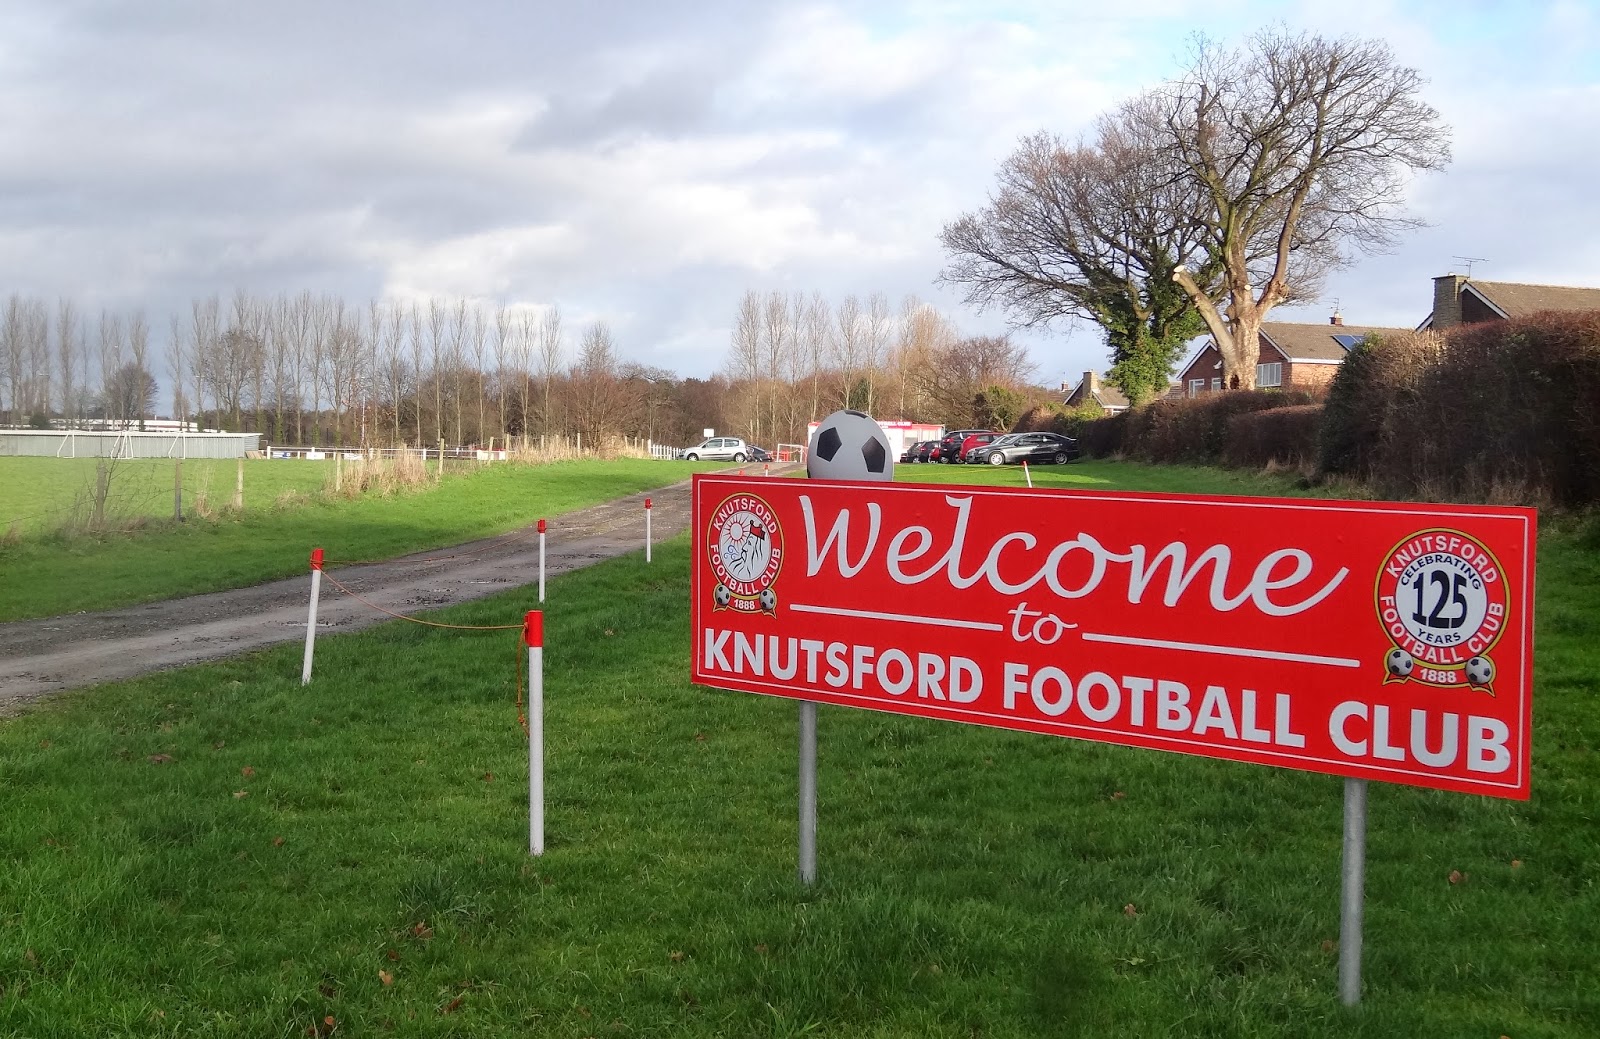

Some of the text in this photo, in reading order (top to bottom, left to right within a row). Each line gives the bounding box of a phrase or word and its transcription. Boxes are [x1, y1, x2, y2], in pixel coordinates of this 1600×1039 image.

[713, 497, 777, 534] KNUTSFORD
[710, 544, 781, 595] FOOTBALL CLUB
[799, 494, 1349, 617] Welcome
[1385, 535, 1497, 583] KNUTSFORD
[1400, 554, 1482, 590] CELEBRATING
[733, 599, 756, 610] 1888
[1412, 569, 1468, 629] 125
[1008, 602, 1078, 645] to
[1380, 595, 1504, 664] FOOTBALL CLUB
[1417, 627, 1462, 645] YEARS
[1420, 667, 1457, 683] 1888
[704, 627, 1511, 774] KNUTSFORD FOOTBALL CLUB
